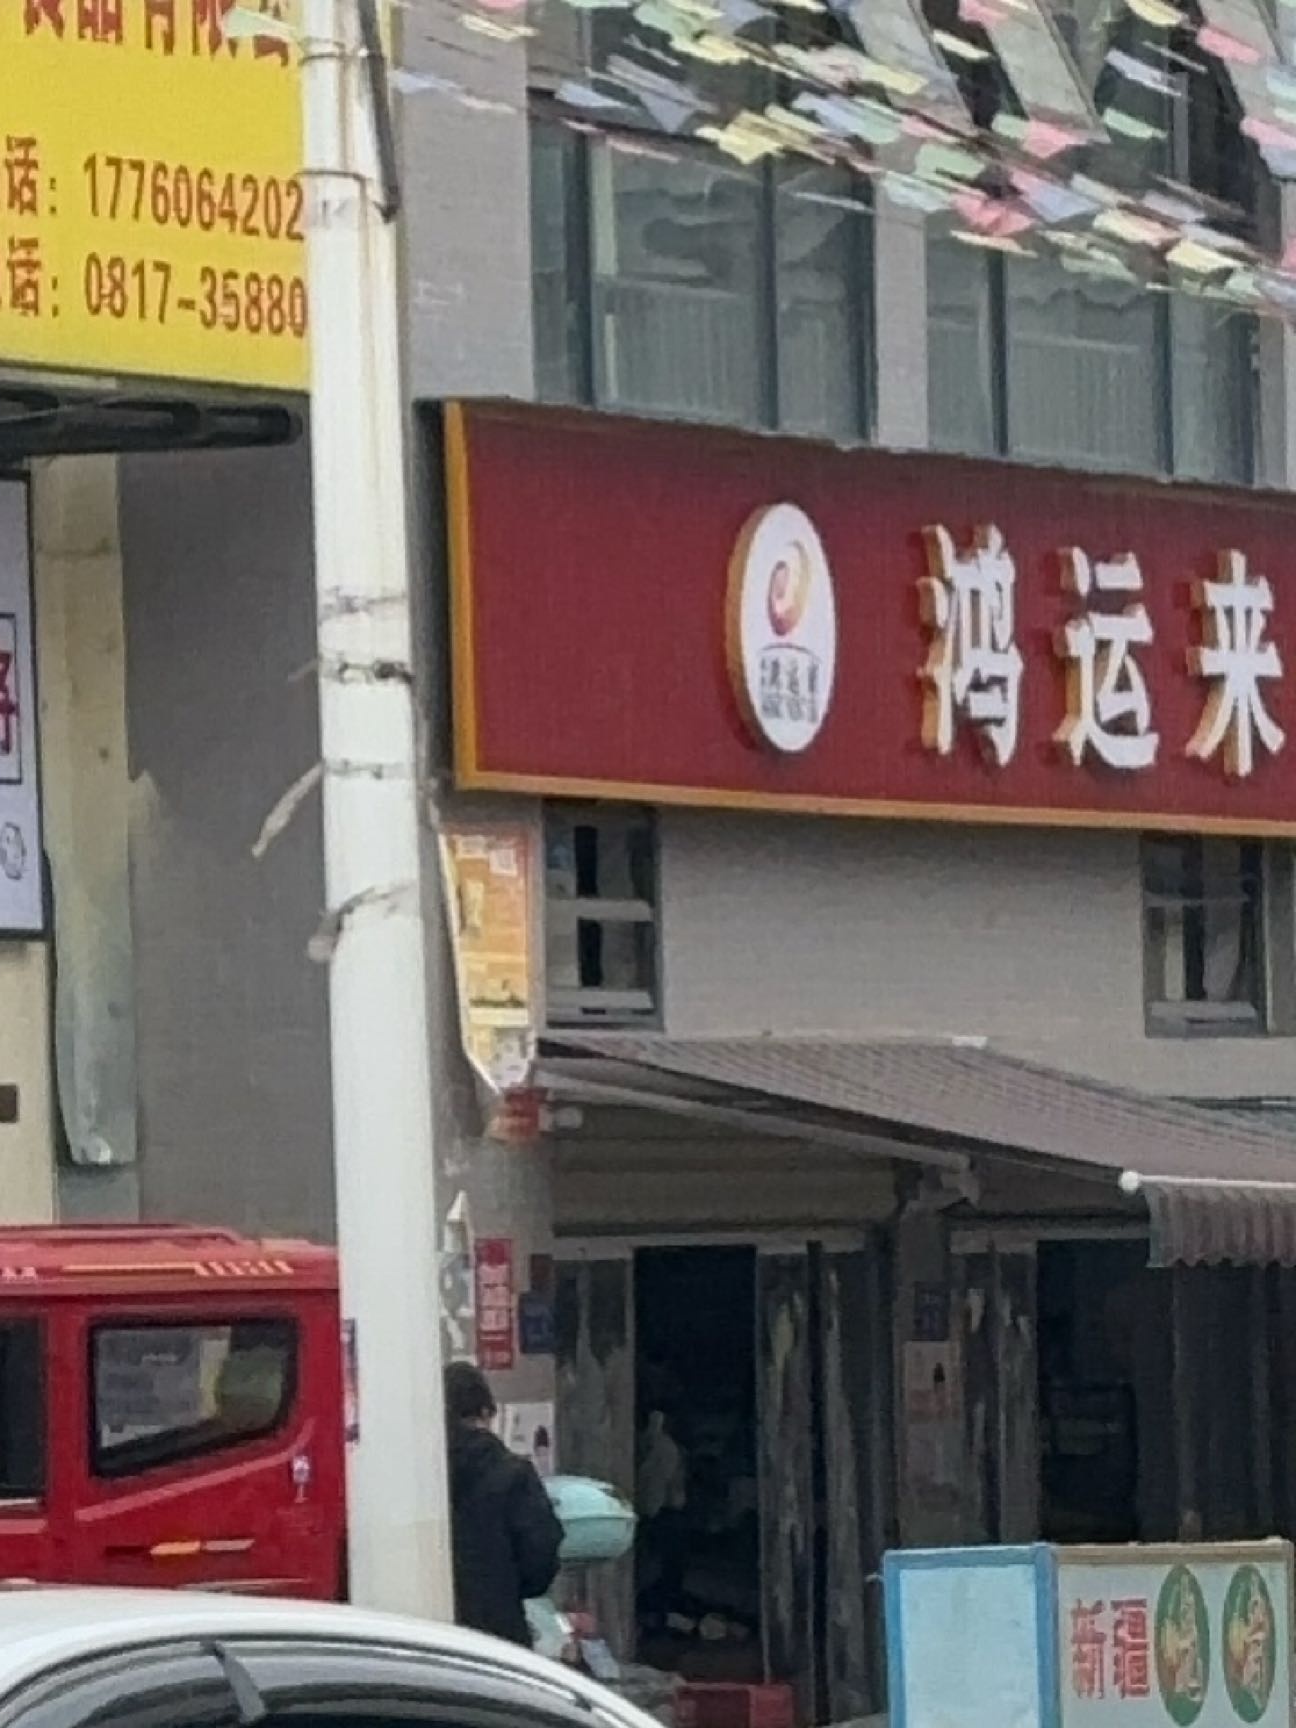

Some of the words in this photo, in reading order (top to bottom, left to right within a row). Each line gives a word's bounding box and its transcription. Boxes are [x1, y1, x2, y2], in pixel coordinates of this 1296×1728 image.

[915, 521, 1287, 778] 鸿运来
[1070, 1597, 1151, 1700] 新疆
